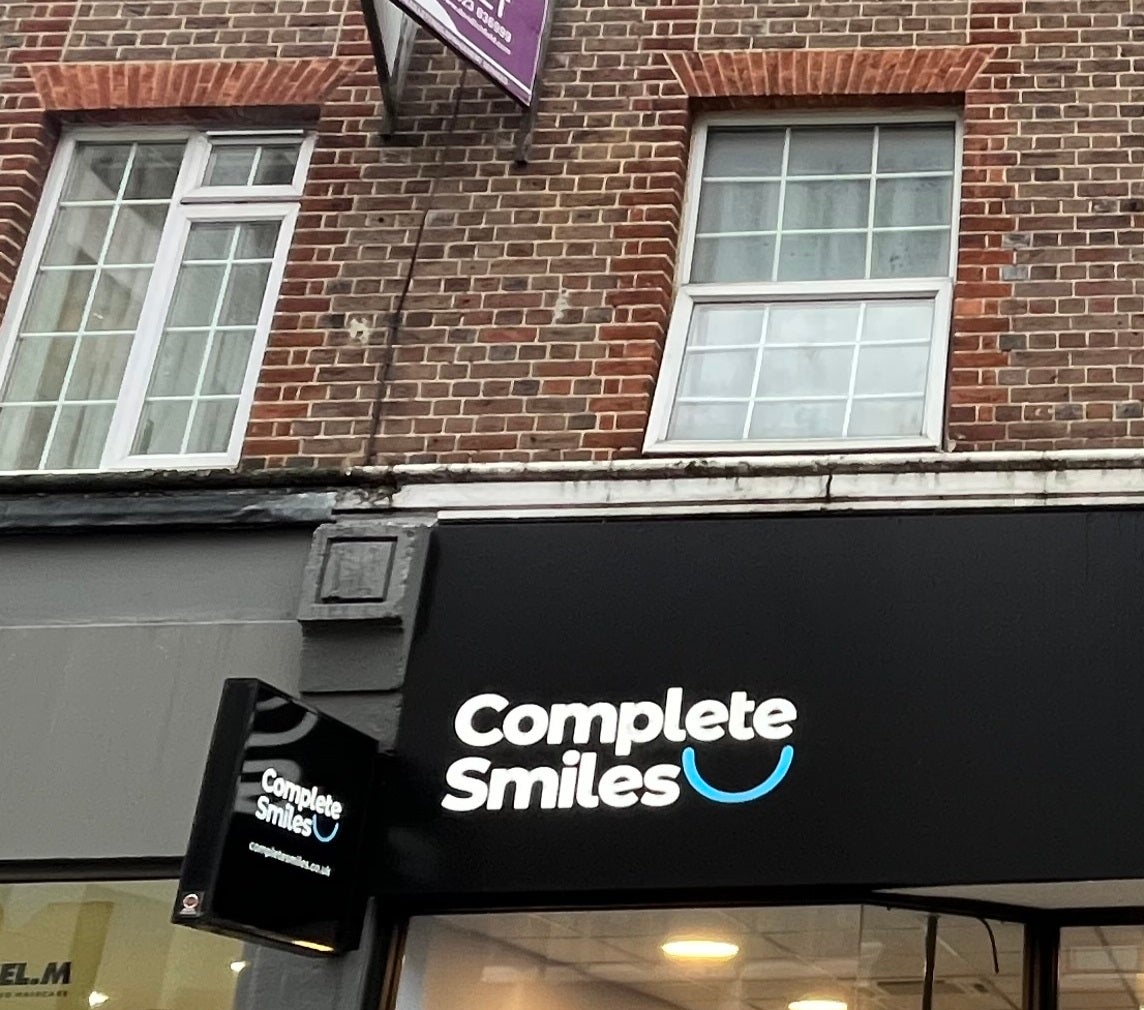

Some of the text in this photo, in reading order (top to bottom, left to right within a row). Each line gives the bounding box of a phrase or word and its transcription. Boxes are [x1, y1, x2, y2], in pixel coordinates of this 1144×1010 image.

[454, 687, 797, 757] Complete
[262, 767, 343, 820] Complete
[441, 750, 682, 812] Smiles
[255, 795, 313, 837] Smiles
